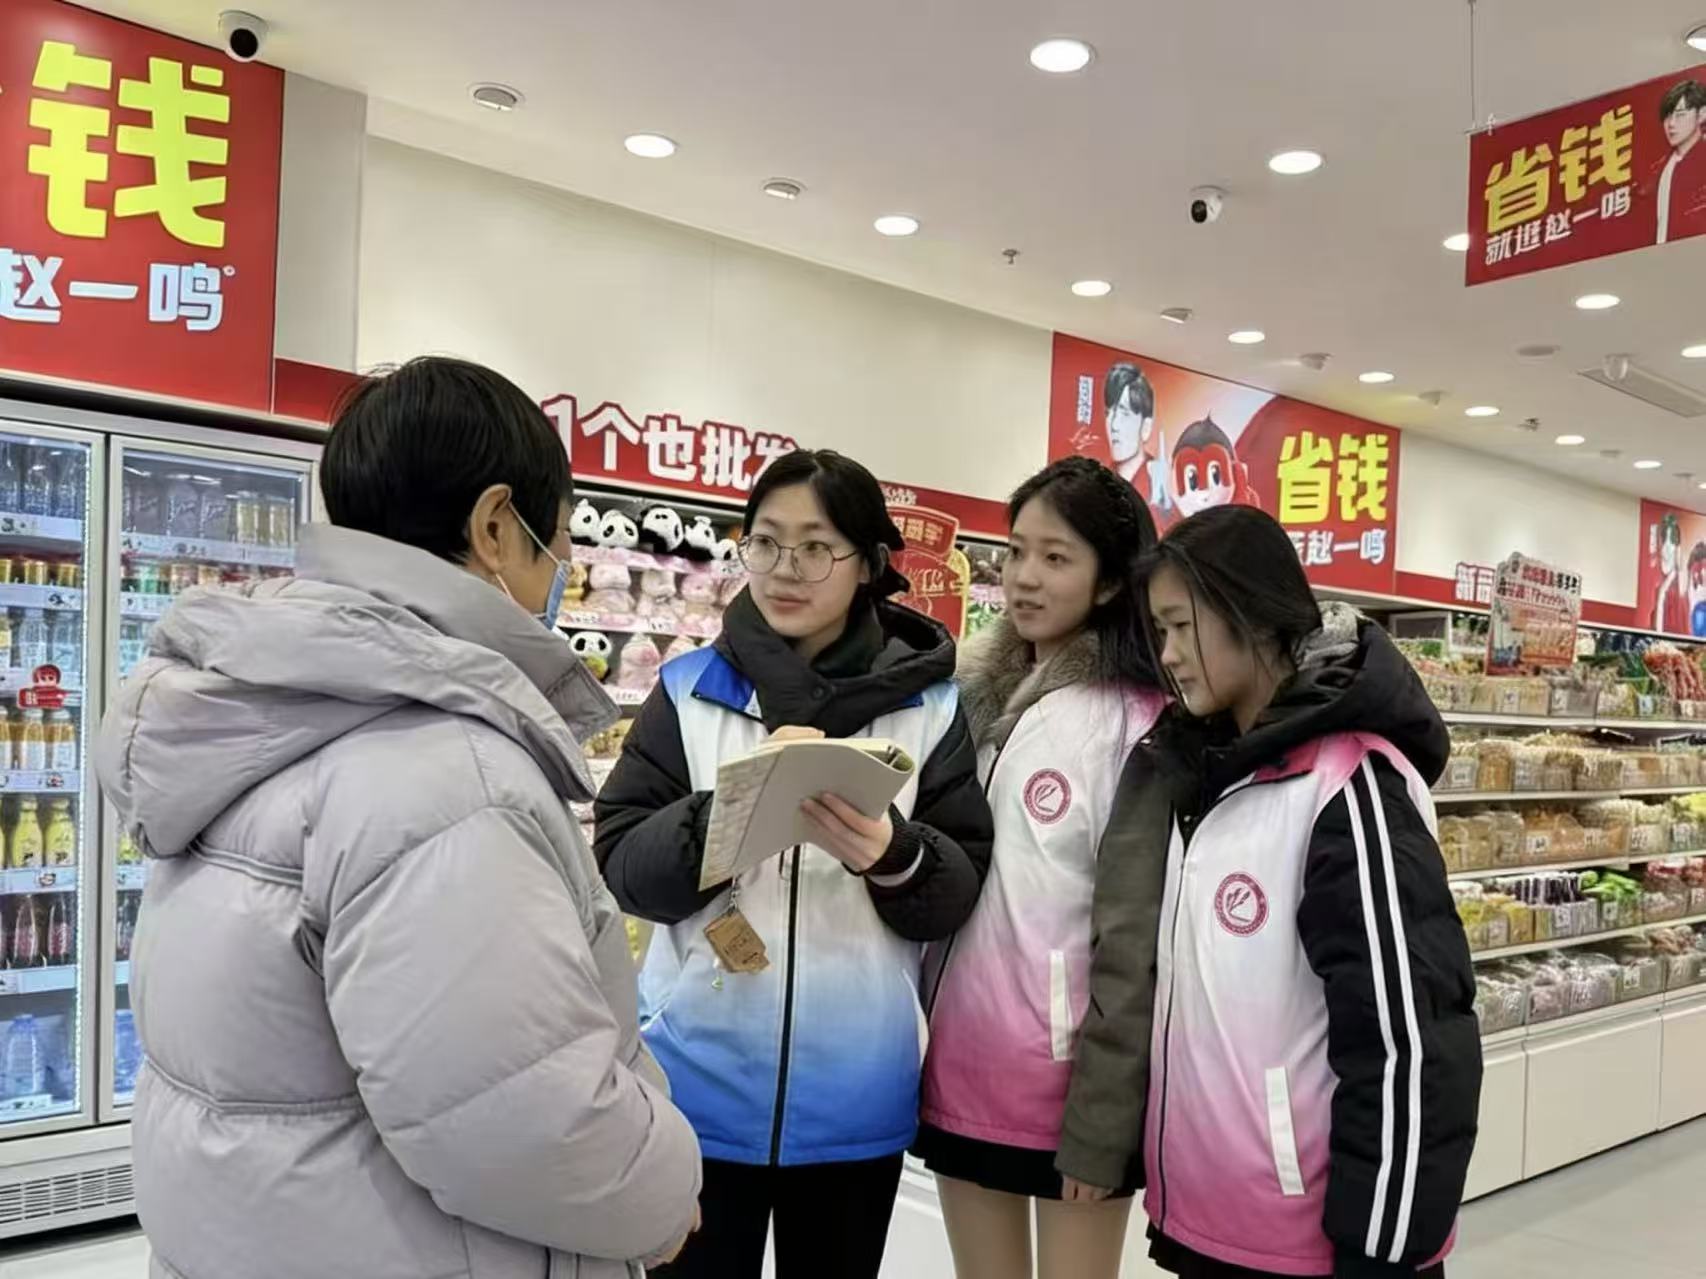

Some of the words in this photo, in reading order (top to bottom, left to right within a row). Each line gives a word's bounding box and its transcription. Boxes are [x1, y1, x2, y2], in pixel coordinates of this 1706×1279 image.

[27, 40, 230, 248] 钱
[1484, 104, 1634, 235] 省钱
[1485, 186, 1632, 266] 就逛赵一鸣
[1277, 431, 1389, 524] 省钱
